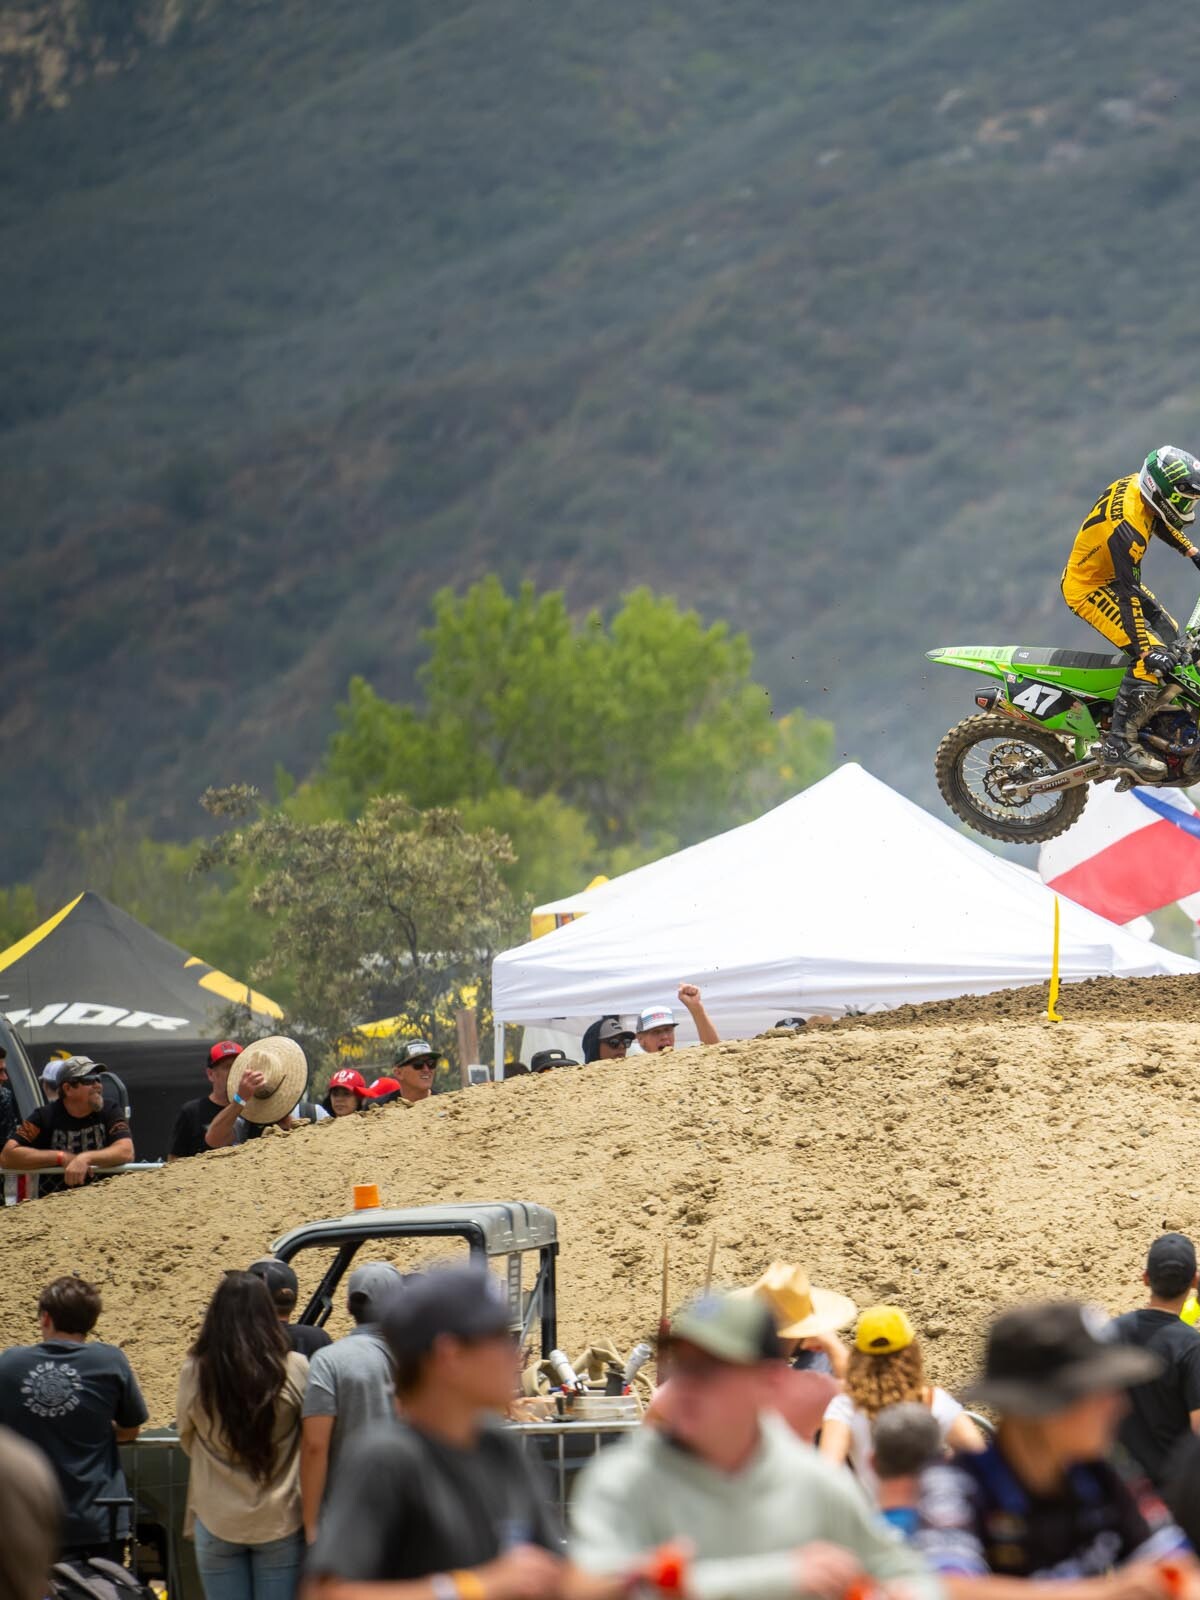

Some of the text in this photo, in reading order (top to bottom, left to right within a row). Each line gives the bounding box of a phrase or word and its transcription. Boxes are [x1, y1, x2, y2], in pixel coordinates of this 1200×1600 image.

[1111, 477, 1132, 521] MMAKER
[1149, 652, 1169, 662] FOX
[1012, 683, 1063, 716] 47
[2, 1000, 190, 1030] HOR
